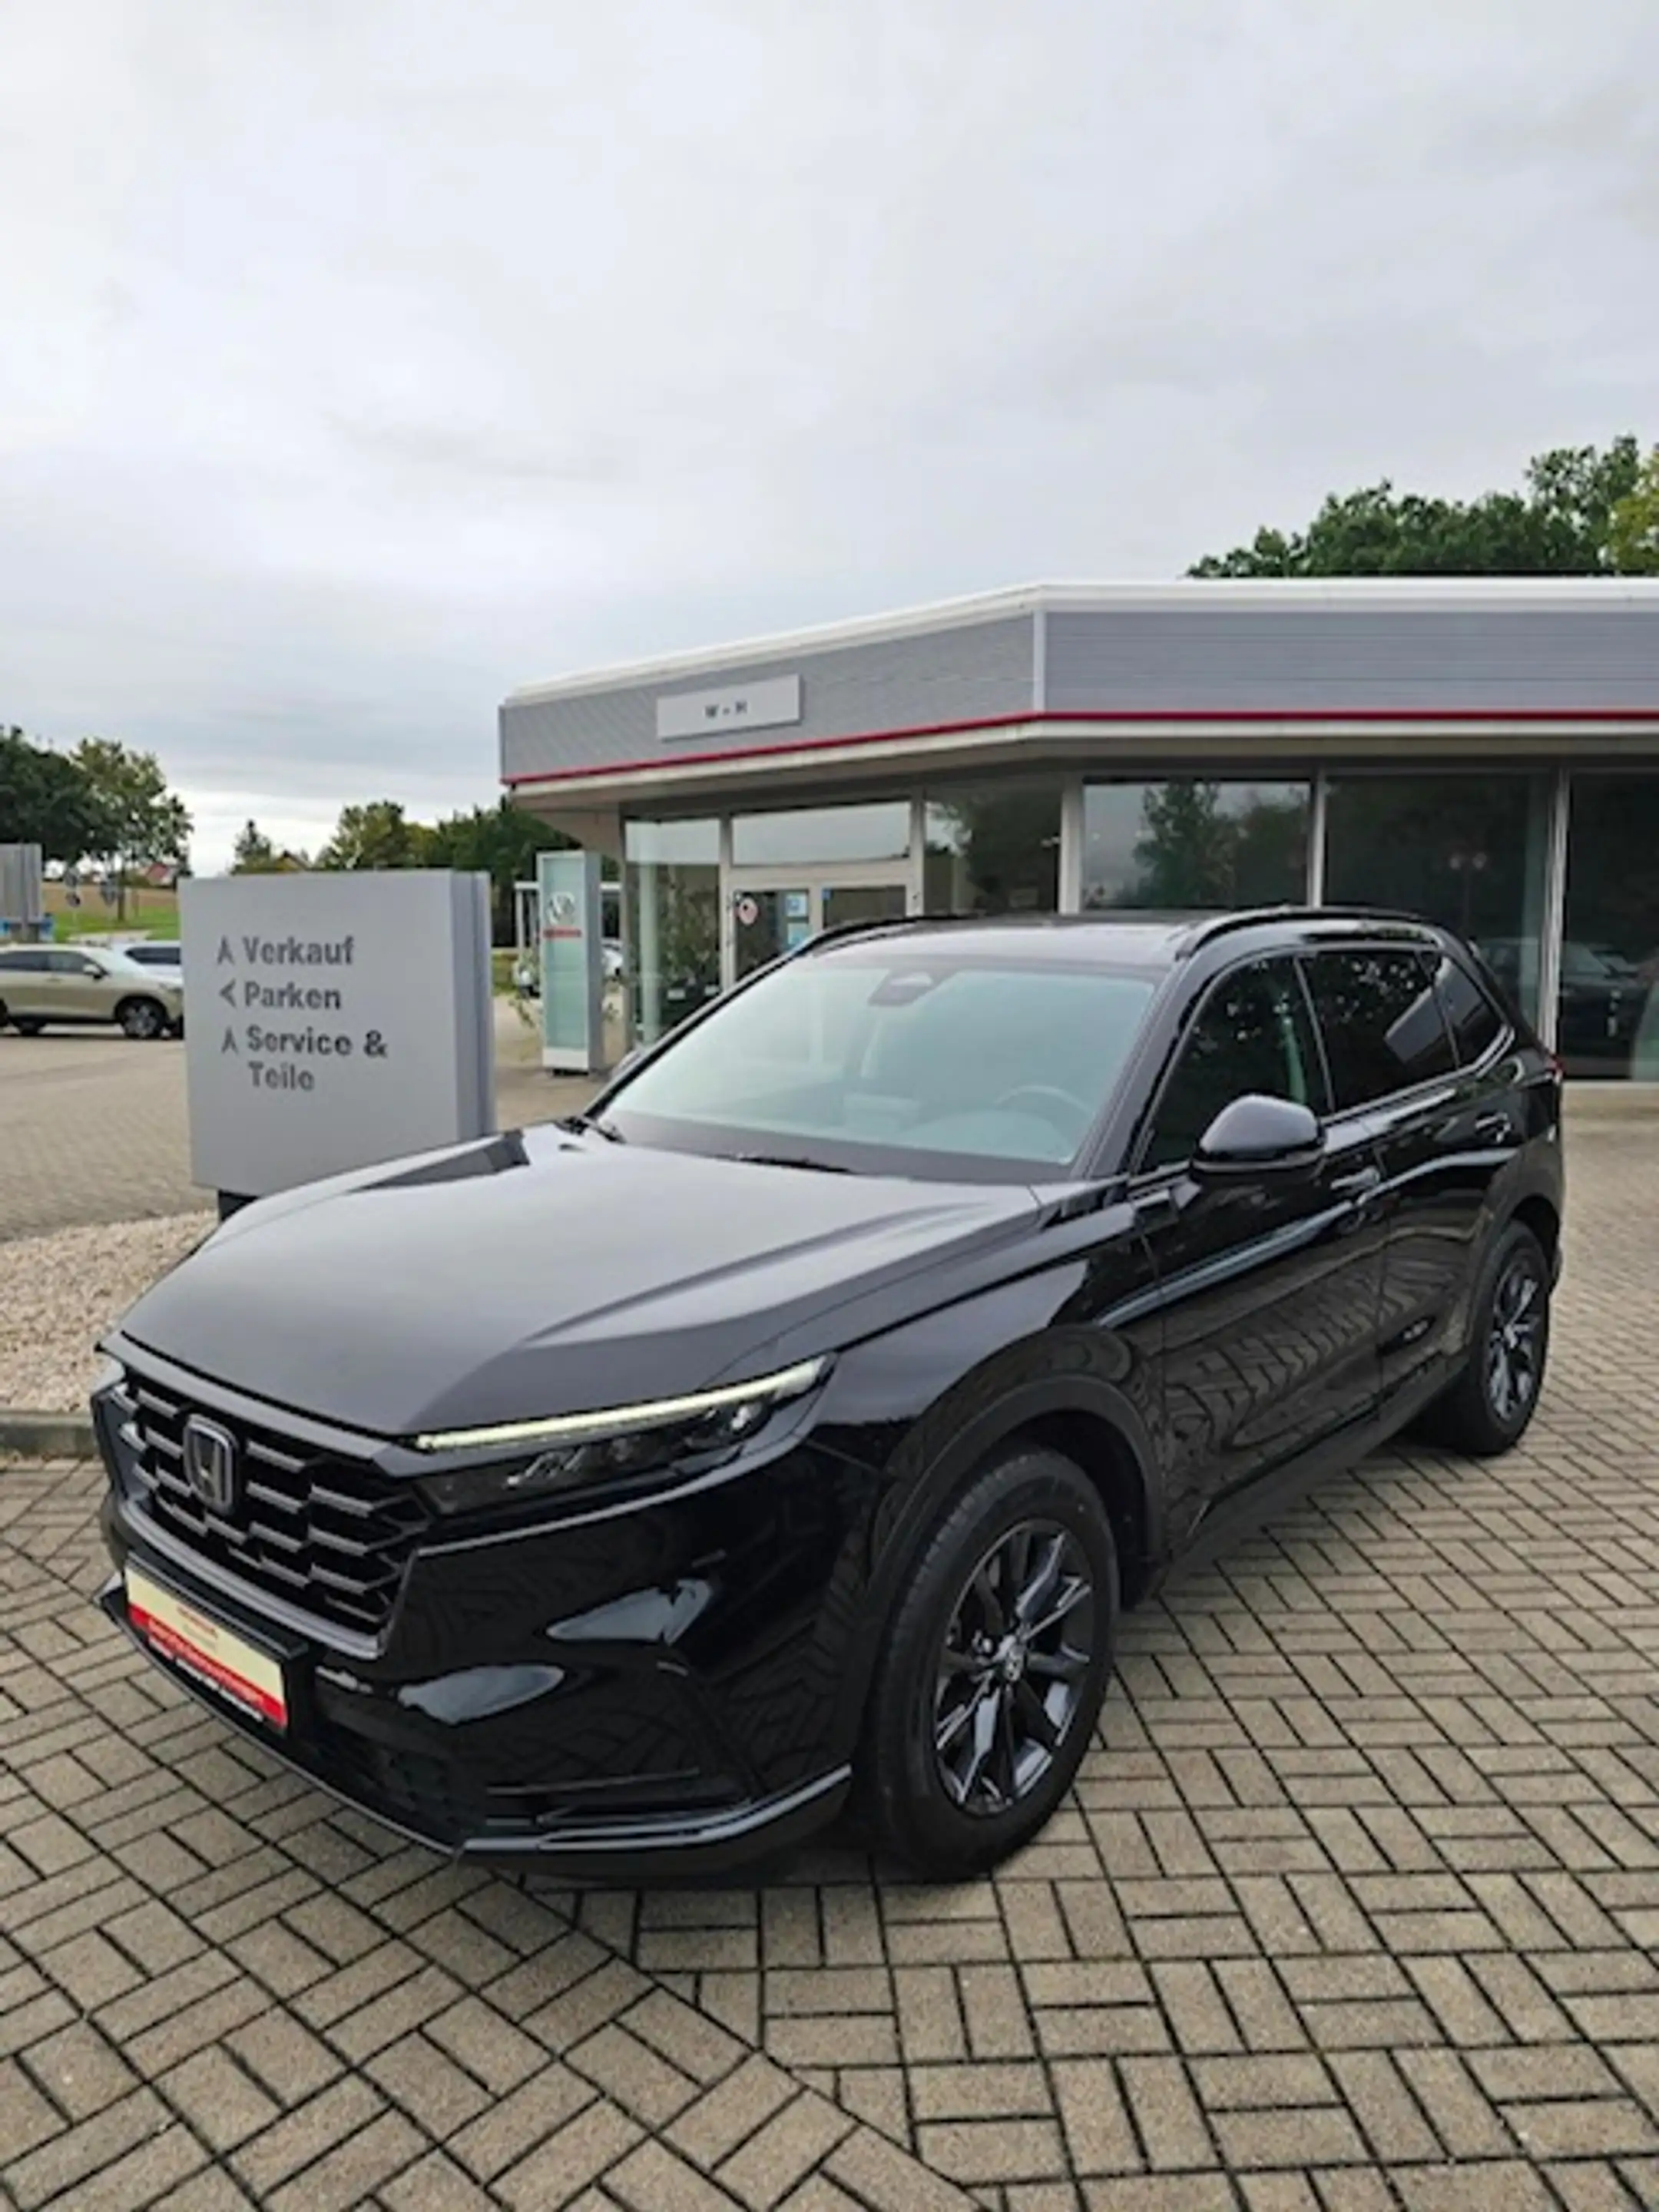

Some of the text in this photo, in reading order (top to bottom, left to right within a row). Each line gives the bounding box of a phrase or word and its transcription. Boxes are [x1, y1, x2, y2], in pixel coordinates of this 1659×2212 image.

[243, 935, 354, 965] Verkauf
[244, 980, 341, 1010] Parken
[246, 1024, 389, 1058] Service &
[248, 1061, 315, 1091] Teile
